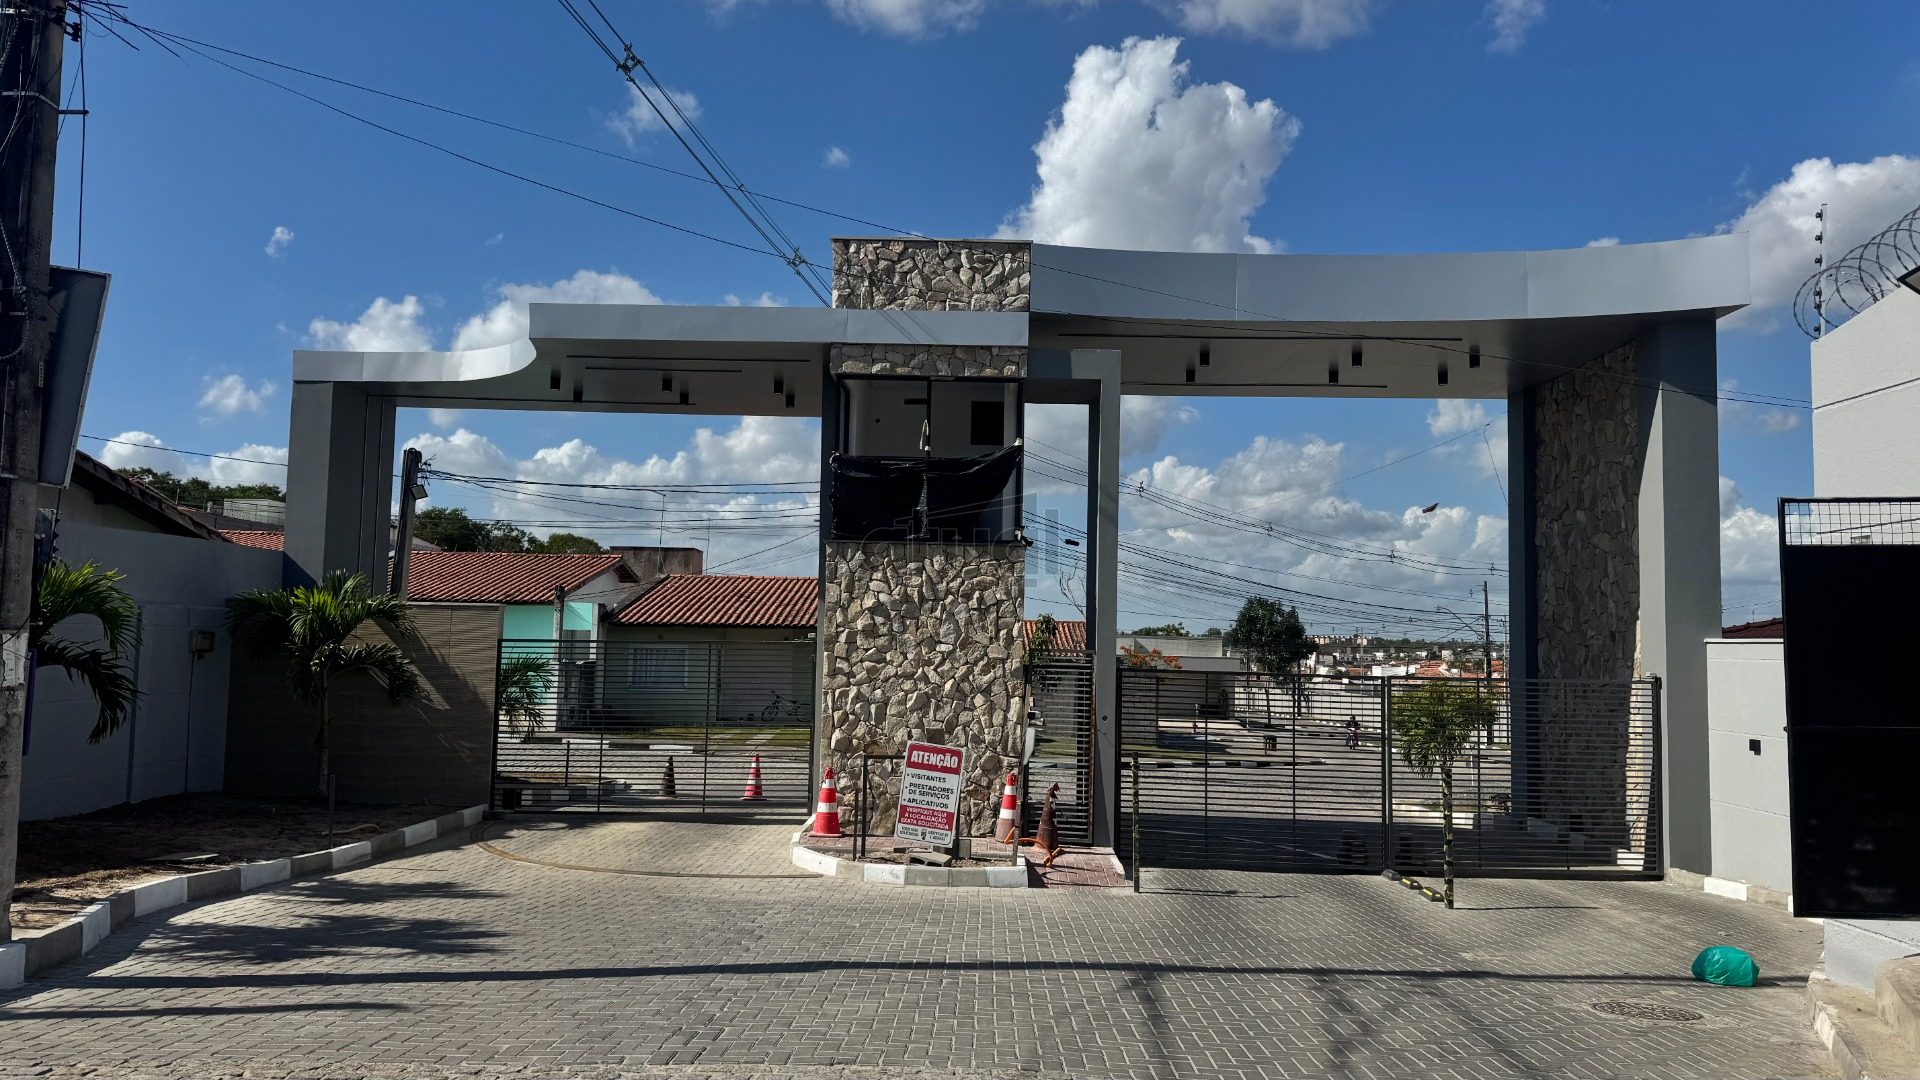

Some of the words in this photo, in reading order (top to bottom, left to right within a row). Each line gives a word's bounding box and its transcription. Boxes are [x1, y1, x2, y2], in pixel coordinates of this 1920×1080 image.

[910, 750, 959, 768] ATENÇÃO
[910, 772, 947, 783] VISITANTES
[909, 782, 954, 795] PRESTADORES
[918, 790, 950, 800] SERVIÇOS
[907, 797, 949, 809] APLICATIVOS
[906, 807, 932, 816] VERIFIQUE
[900, 817, 917, 825] EXATA
[917, 820, 949, 830] SOLICITADA
[909, 813, 947, 823] LOCALIZAÇÃO
